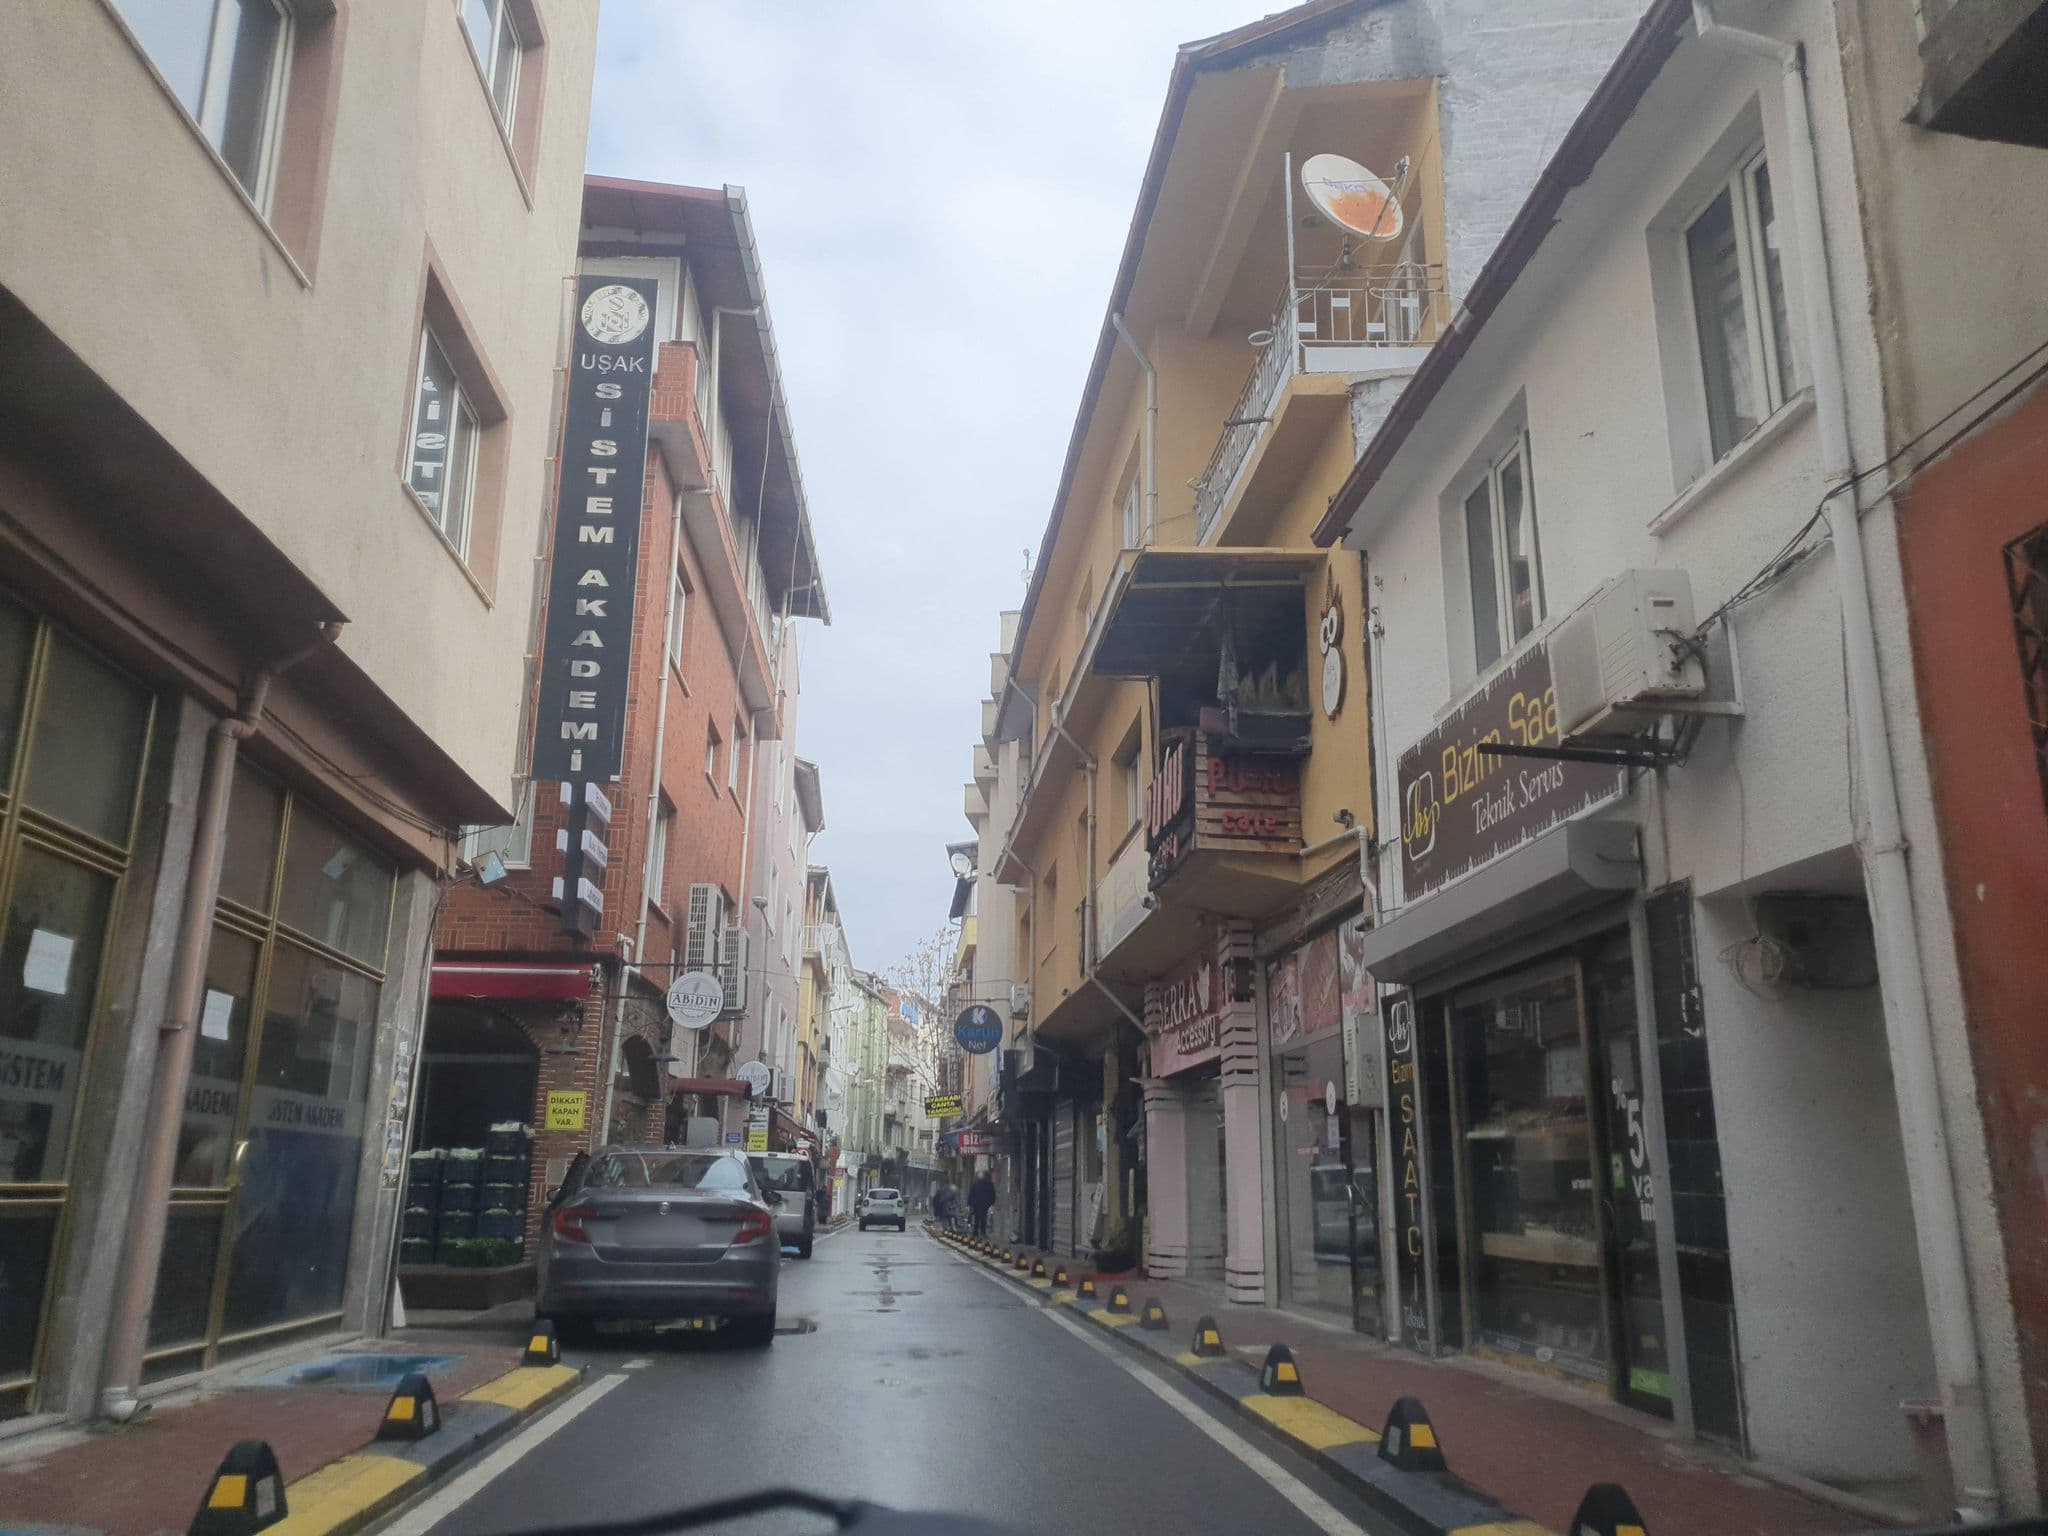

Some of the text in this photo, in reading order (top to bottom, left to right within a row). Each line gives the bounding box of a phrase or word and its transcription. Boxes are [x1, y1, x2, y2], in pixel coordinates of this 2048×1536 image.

[581, 353, 645, 375] UŞAK
[578, 383, 623, 544] SİSTEM
[560, 569, 609, 772] AKADEMİ
[1442, 726, 1502, 805] Bizim
[1472, 762, 1565, 834] Teknik Servis
[552, 1107, 579, 1115] KAPAN
